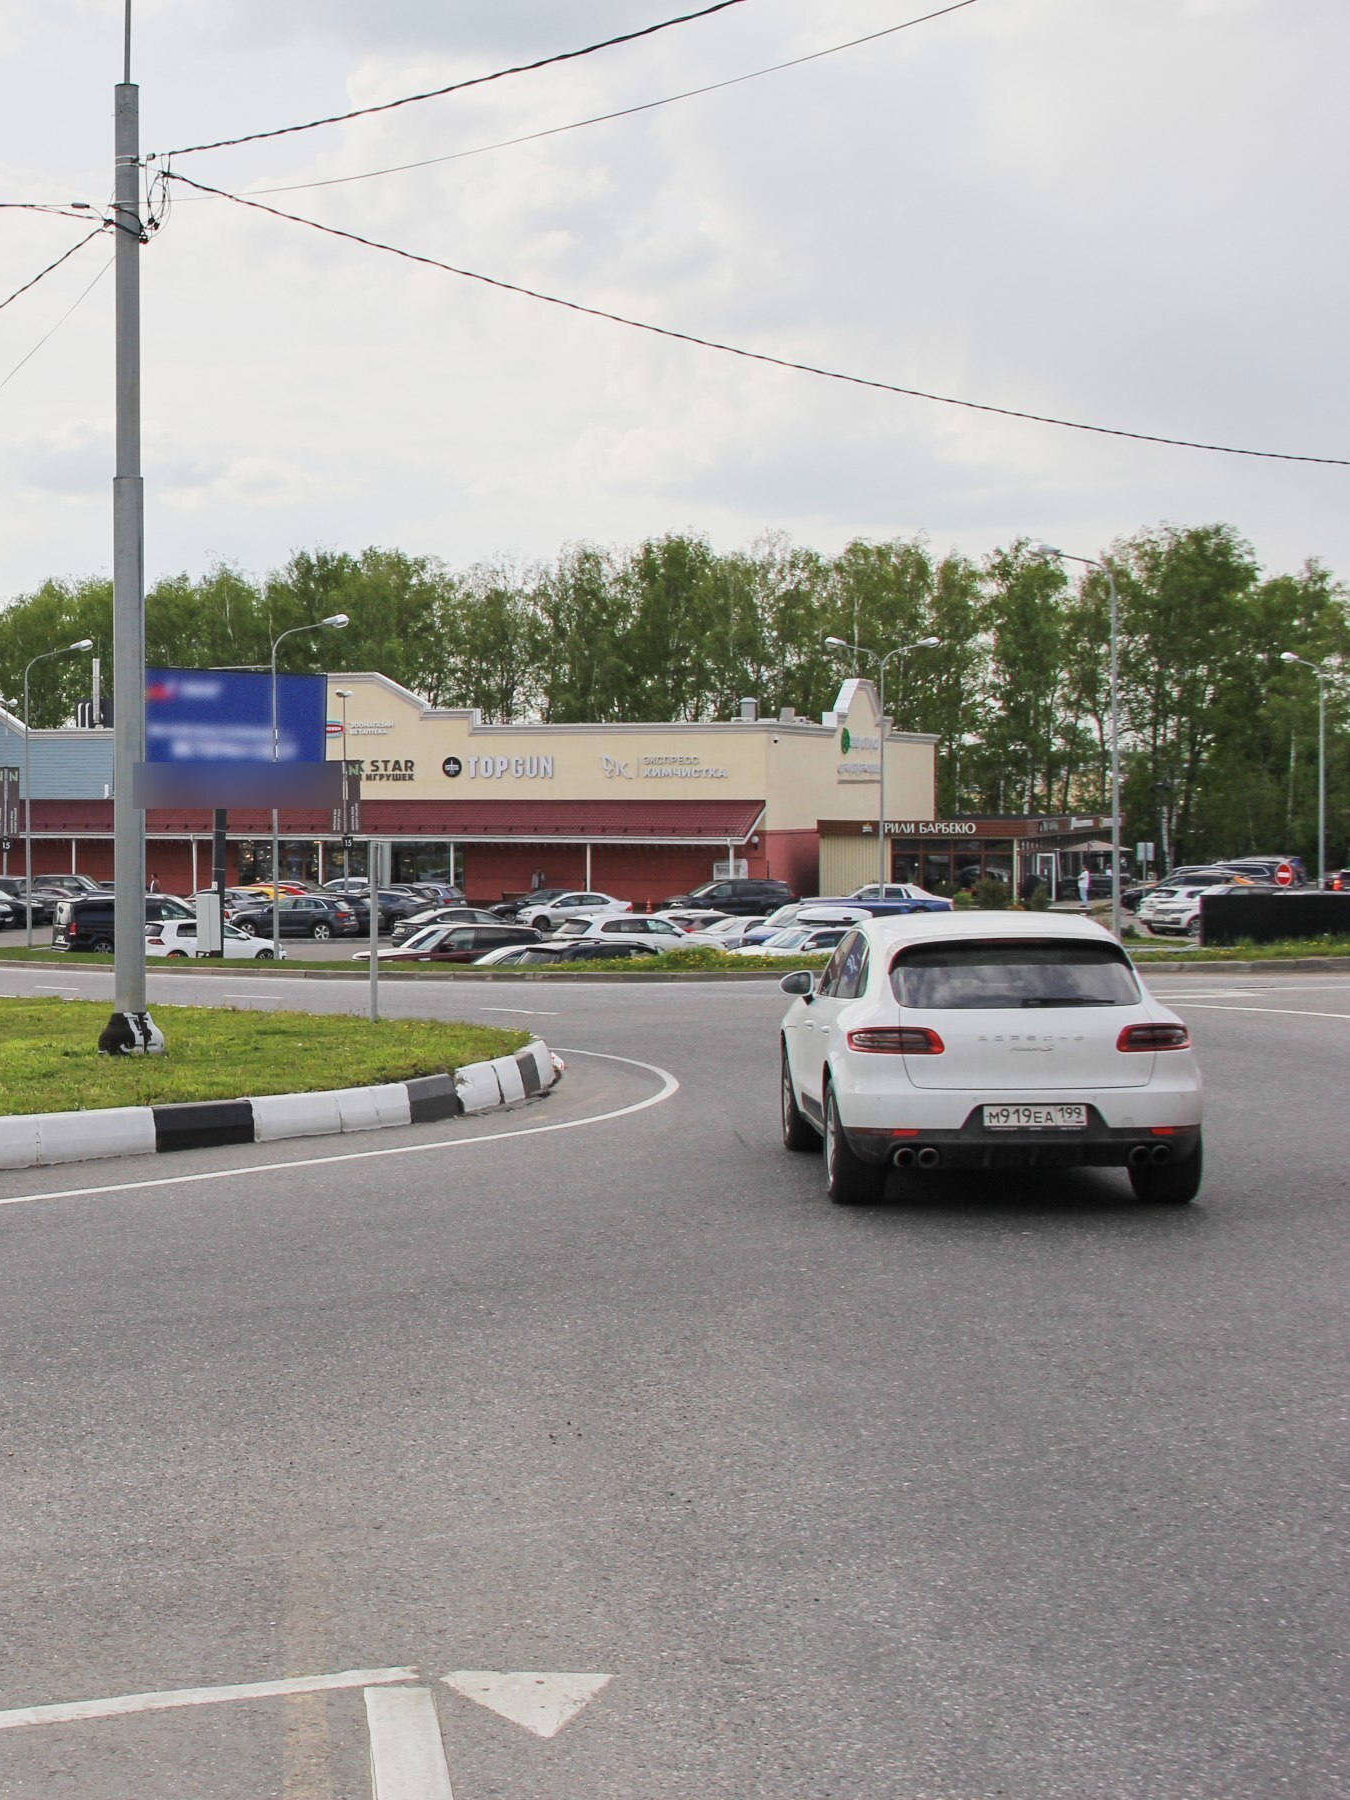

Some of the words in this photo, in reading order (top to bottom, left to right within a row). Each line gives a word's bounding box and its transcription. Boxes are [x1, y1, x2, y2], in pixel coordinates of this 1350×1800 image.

[370, 760, 415, 773] STAR
[643, 756, 699, 766] ЭКСПРЕСС
[467, 756, 554, 779] TOPGUN
[643, 767, 728, 779] ХИМЧИСТКА
[365, 773, 415, 782] ИГРУШЕК
[883, 822, 915, 834] РИЛИ
[919, 822, 976, 834] БАРБЕКЮ
[2, 841, 11, 849] 15
[1058, 1107, 1082, 1119] 199
